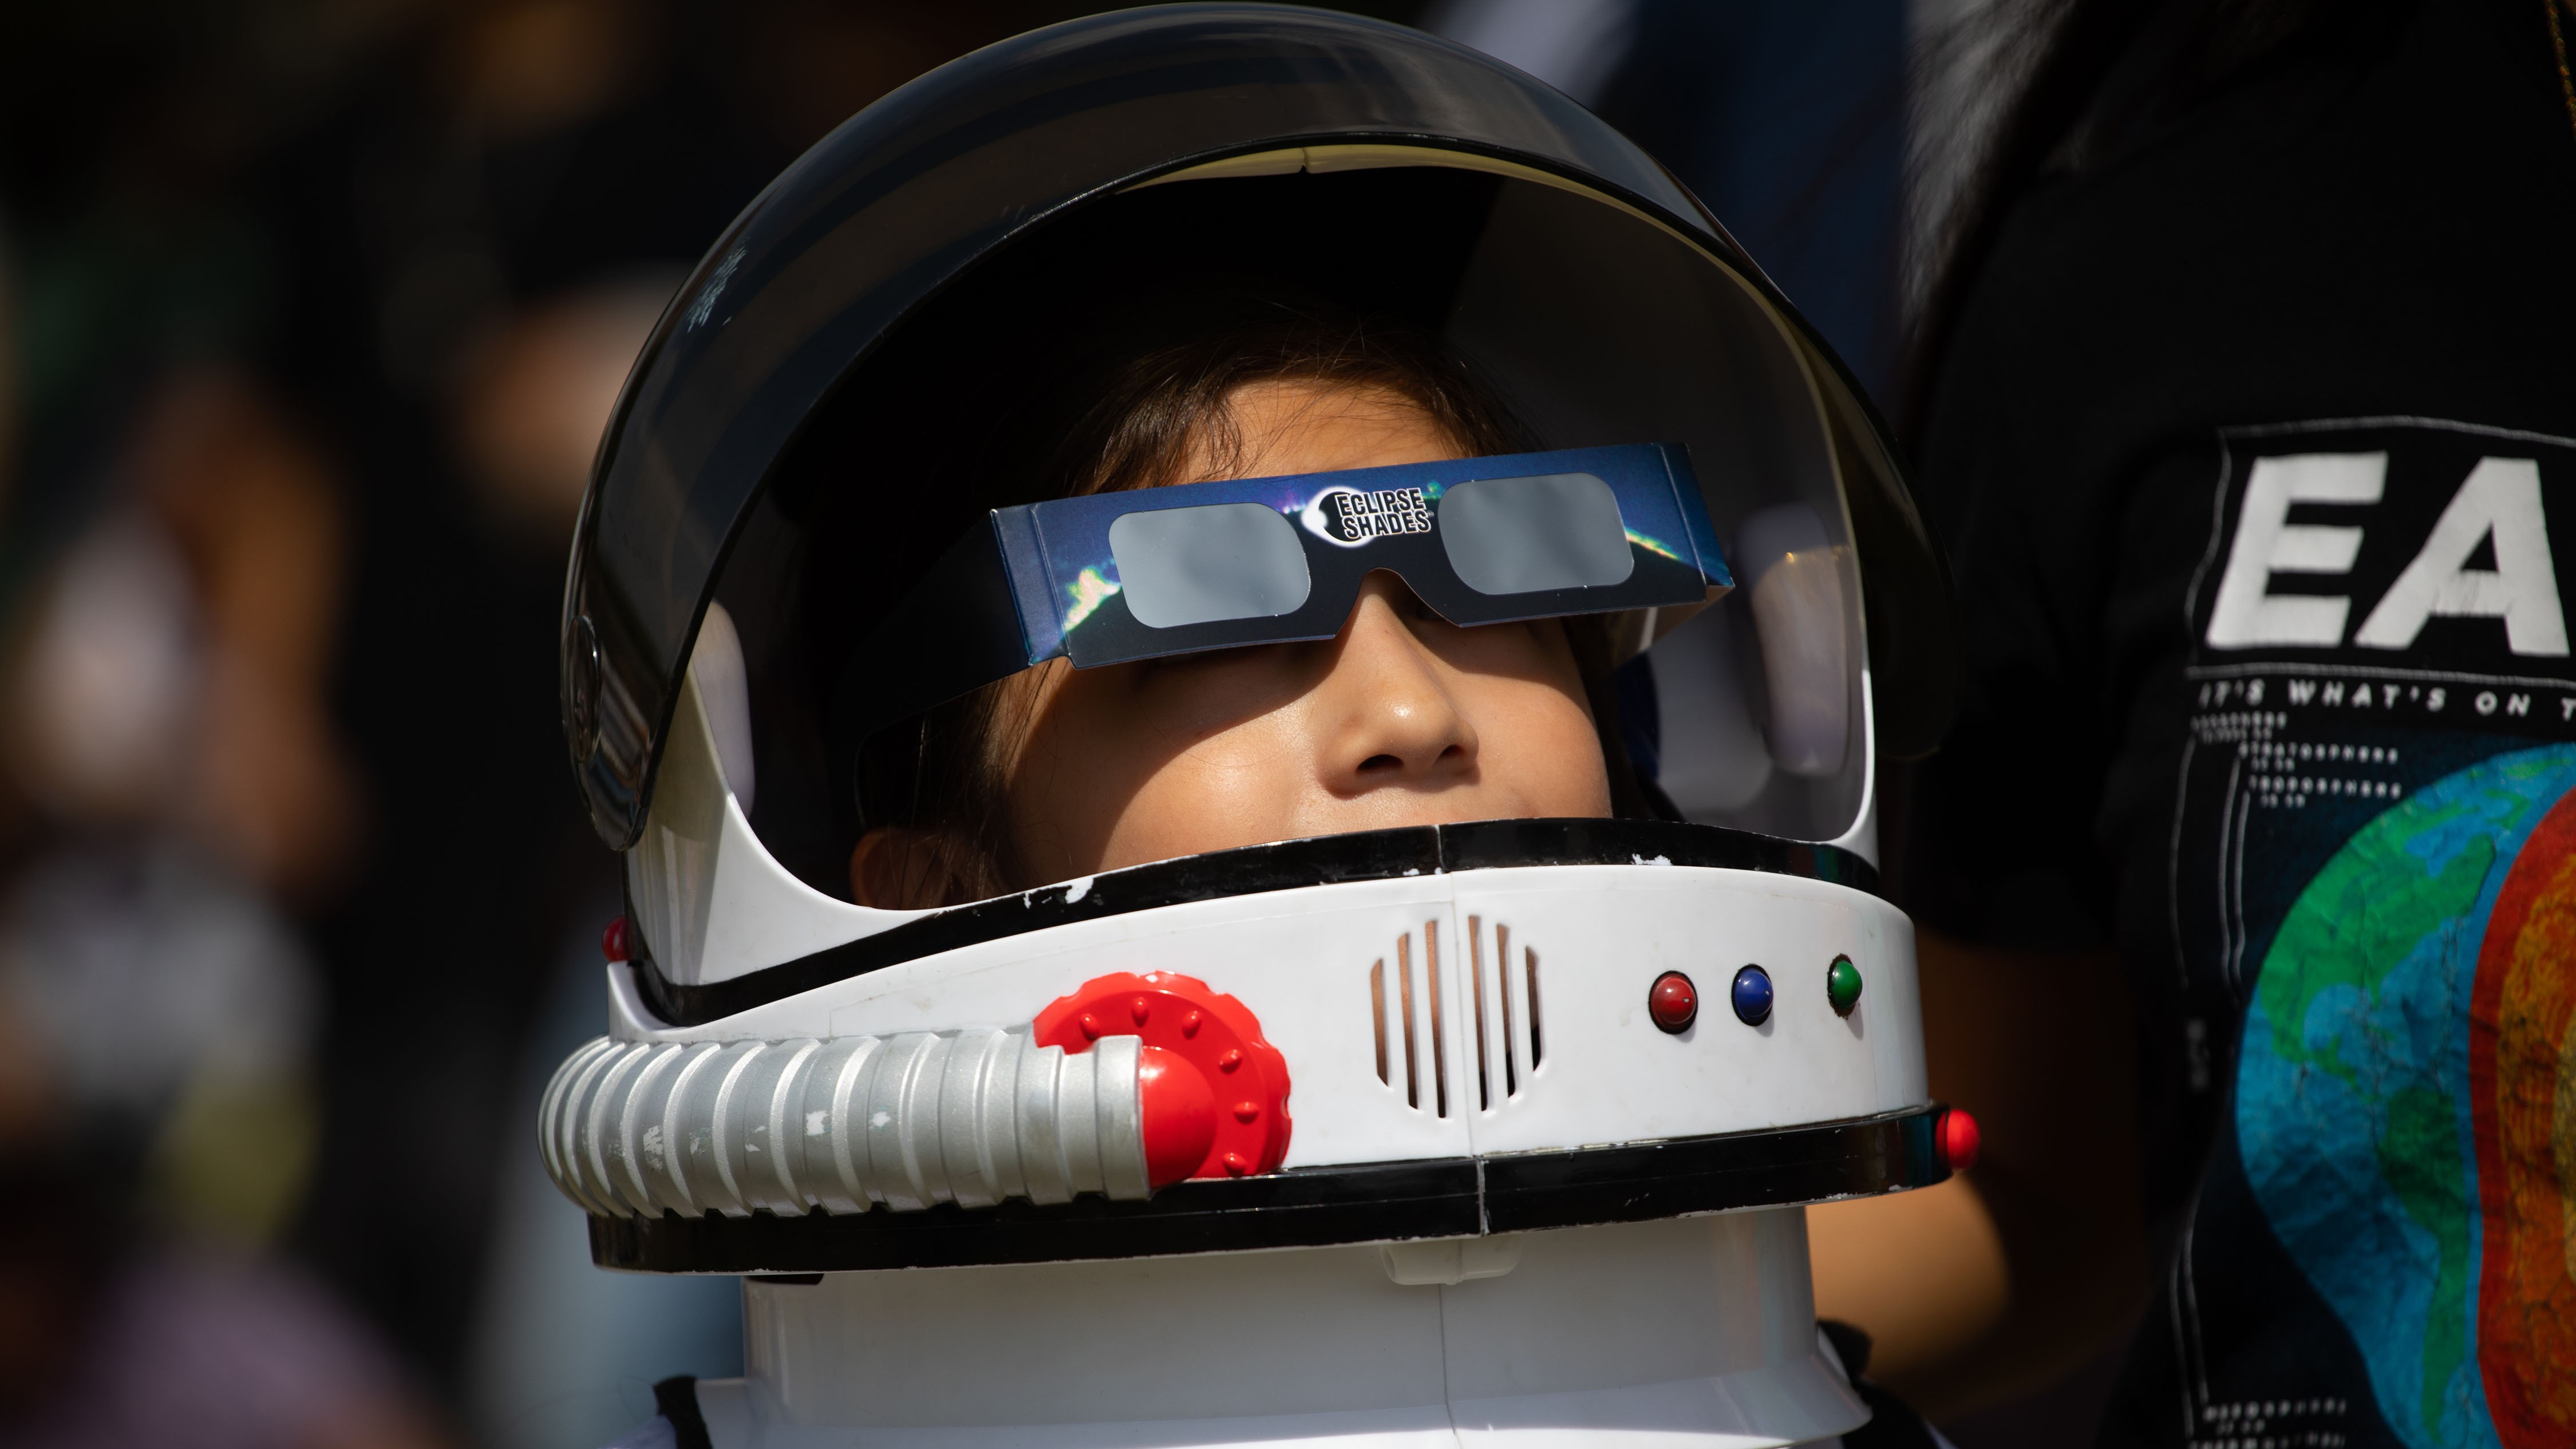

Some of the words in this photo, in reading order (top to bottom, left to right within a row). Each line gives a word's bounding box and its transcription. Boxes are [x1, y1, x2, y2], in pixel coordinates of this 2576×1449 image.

[1335, 487, 1426, 517] ECLIPSE
[2205, 451, 2570, 657] EA
[2198, 678, 2266, 710] IT'S
[2287, 679, 2446, 712] WHAT'S
[2474, 690, 2531, 717] ON
